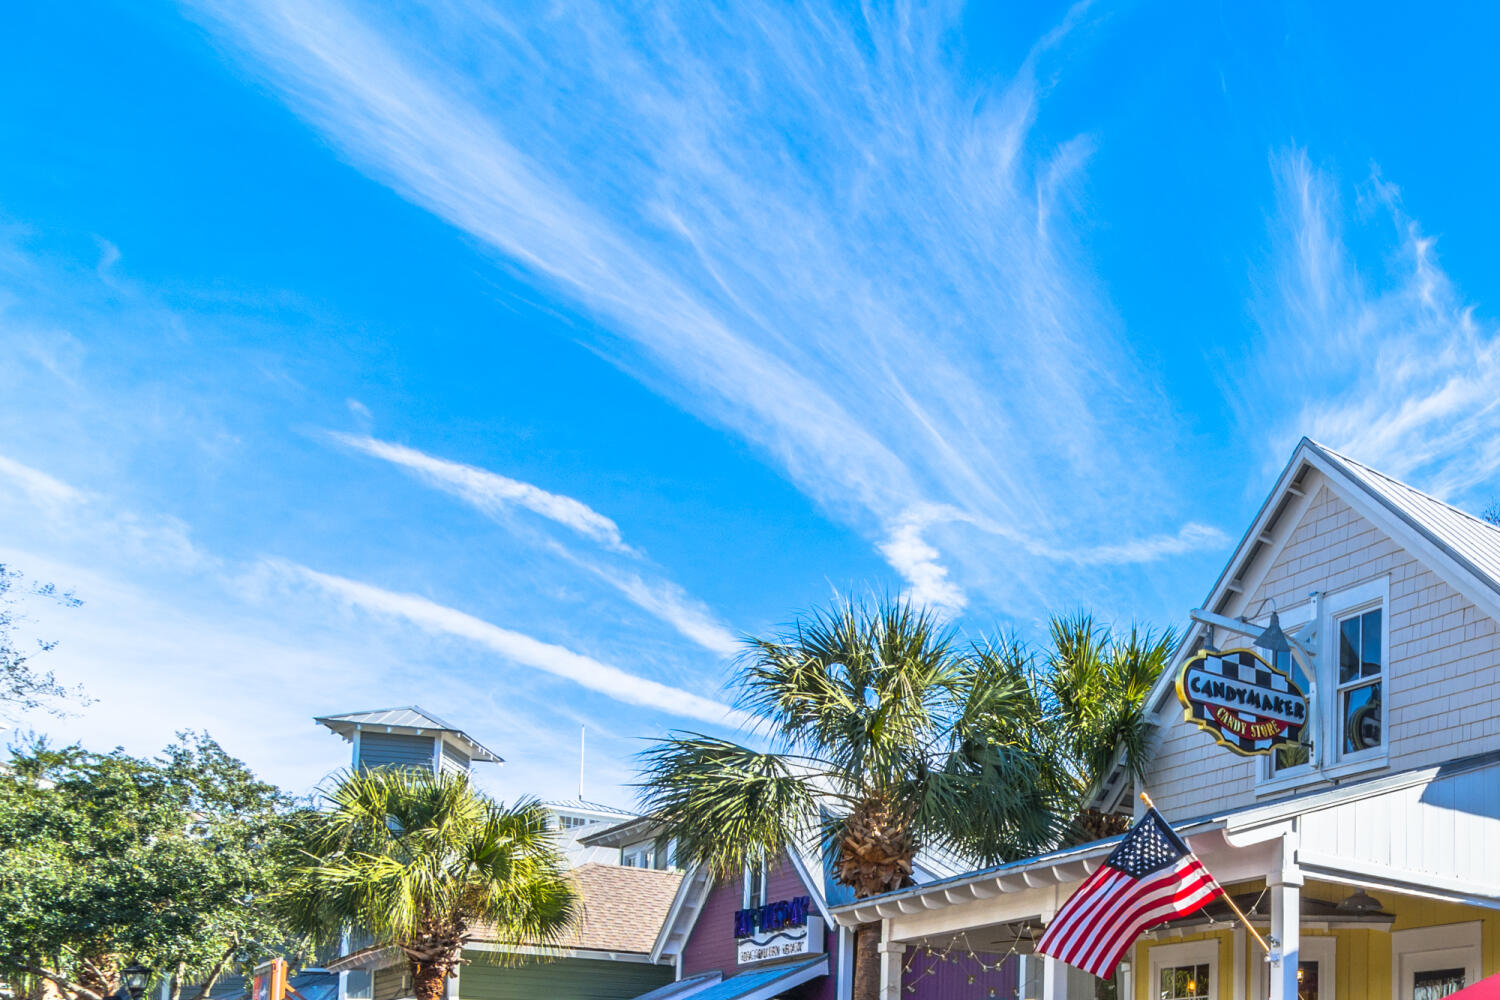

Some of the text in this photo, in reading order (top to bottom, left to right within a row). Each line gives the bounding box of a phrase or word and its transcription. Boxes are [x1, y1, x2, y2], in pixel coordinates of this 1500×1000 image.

[1190, 676, 1305, 720] CANDYMAKER
[1216, 707, 1281, 738] CANDY STORE
